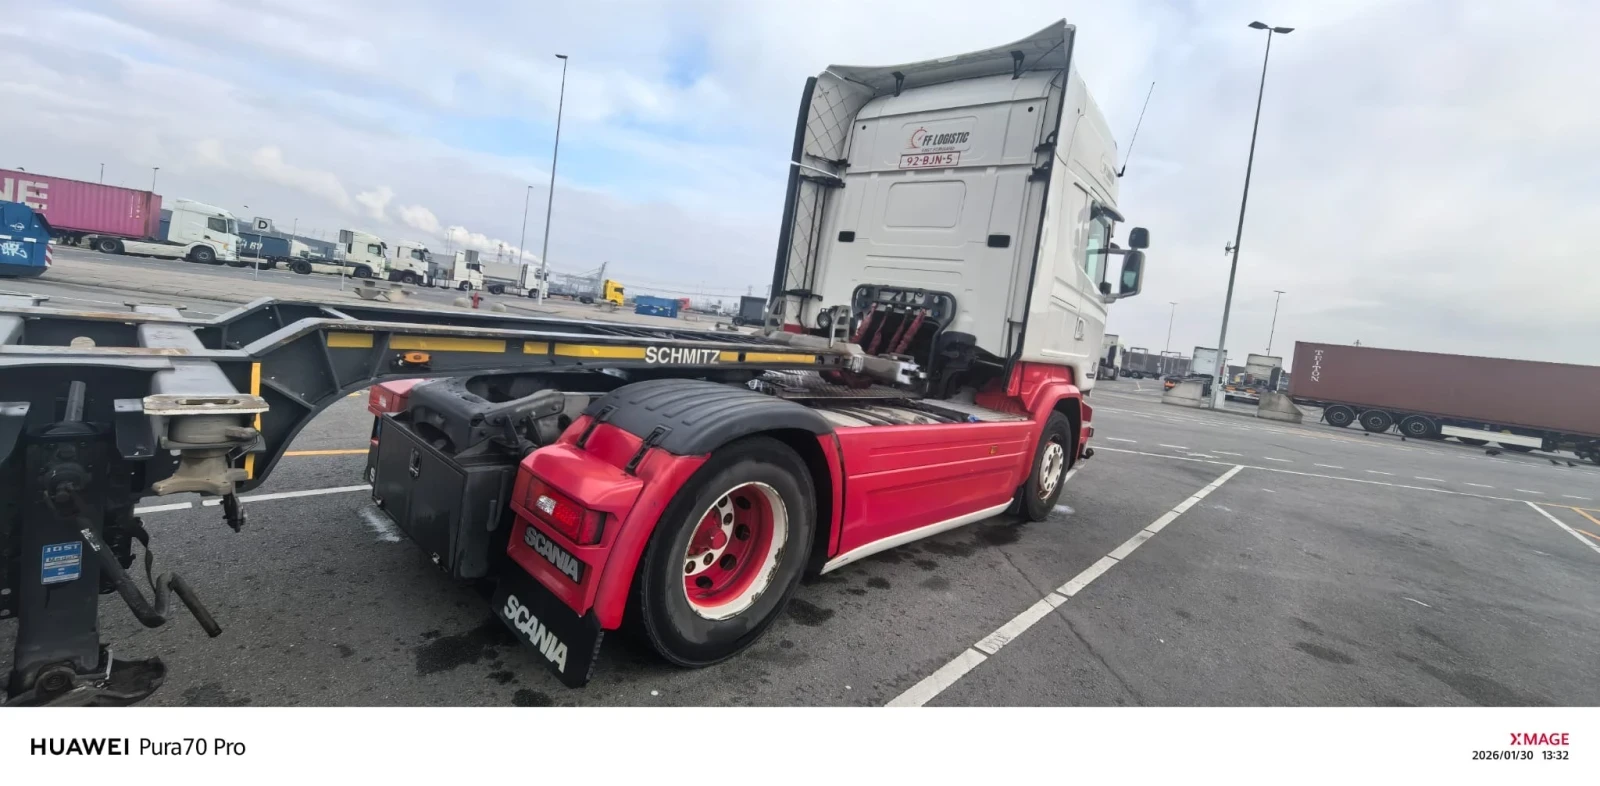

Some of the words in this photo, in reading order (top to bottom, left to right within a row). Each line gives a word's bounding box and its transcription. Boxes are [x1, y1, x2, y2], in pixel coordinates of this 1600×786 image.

[922, 135, 933, 147] FF
[933, 131, 970, 146] LOGISTIC
[907, 154, 953, 166] 92-BJN-5
[258, 220, 268, 229] D
[645, 346, 720, 364] SCHMITZ
[1311, 349, 1324, 382] TRITON
[524, 526, 579, 582] SCANIA
[503, 594, 569, 674] SCANIA
